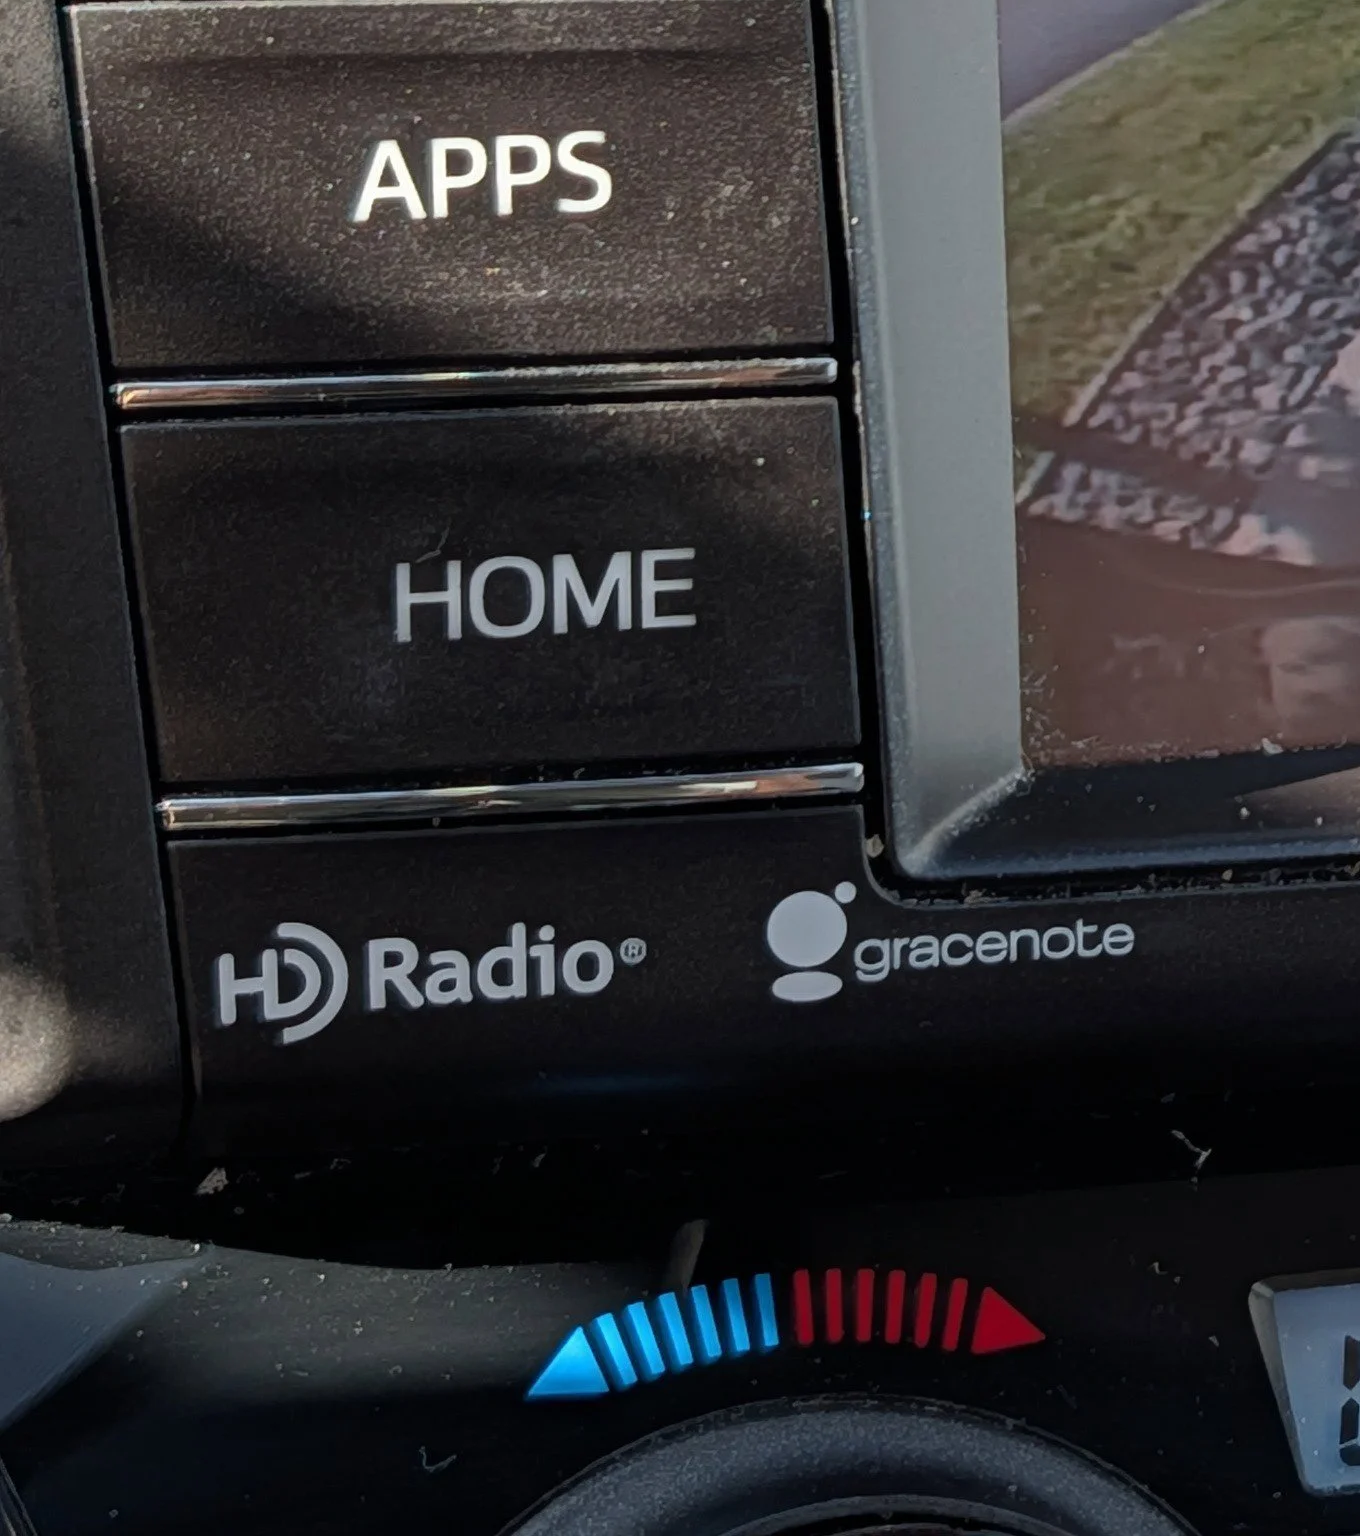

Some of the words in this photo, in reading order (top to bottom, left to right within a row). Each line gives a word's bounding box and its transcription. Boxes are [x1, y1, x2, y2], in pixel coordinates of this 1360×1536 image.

[352, 130, 613, 222] APPS
[394, 547, 697, 643] HOME
[853, 918, 1135, 983] gracenote
